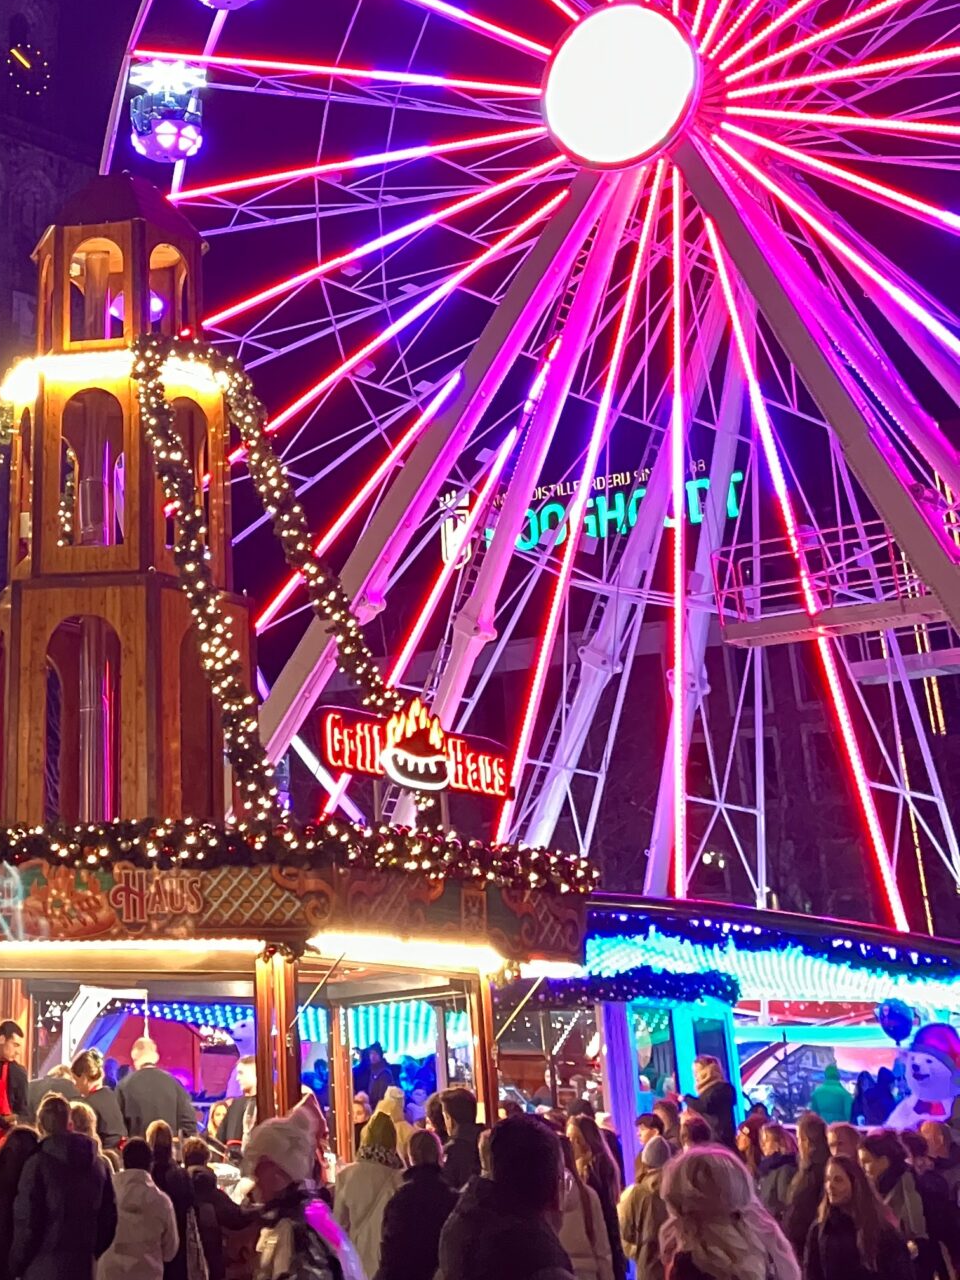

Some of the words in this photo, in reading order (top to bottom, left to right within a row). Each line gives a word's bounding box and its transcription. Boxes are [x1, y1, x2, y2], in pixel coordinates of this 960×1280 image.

[485, 471, 744, 552] OOGHODT
[531, 471, 630, 501] DISTILLERDERIJ
[109, 869, 204, 923] HAUS
